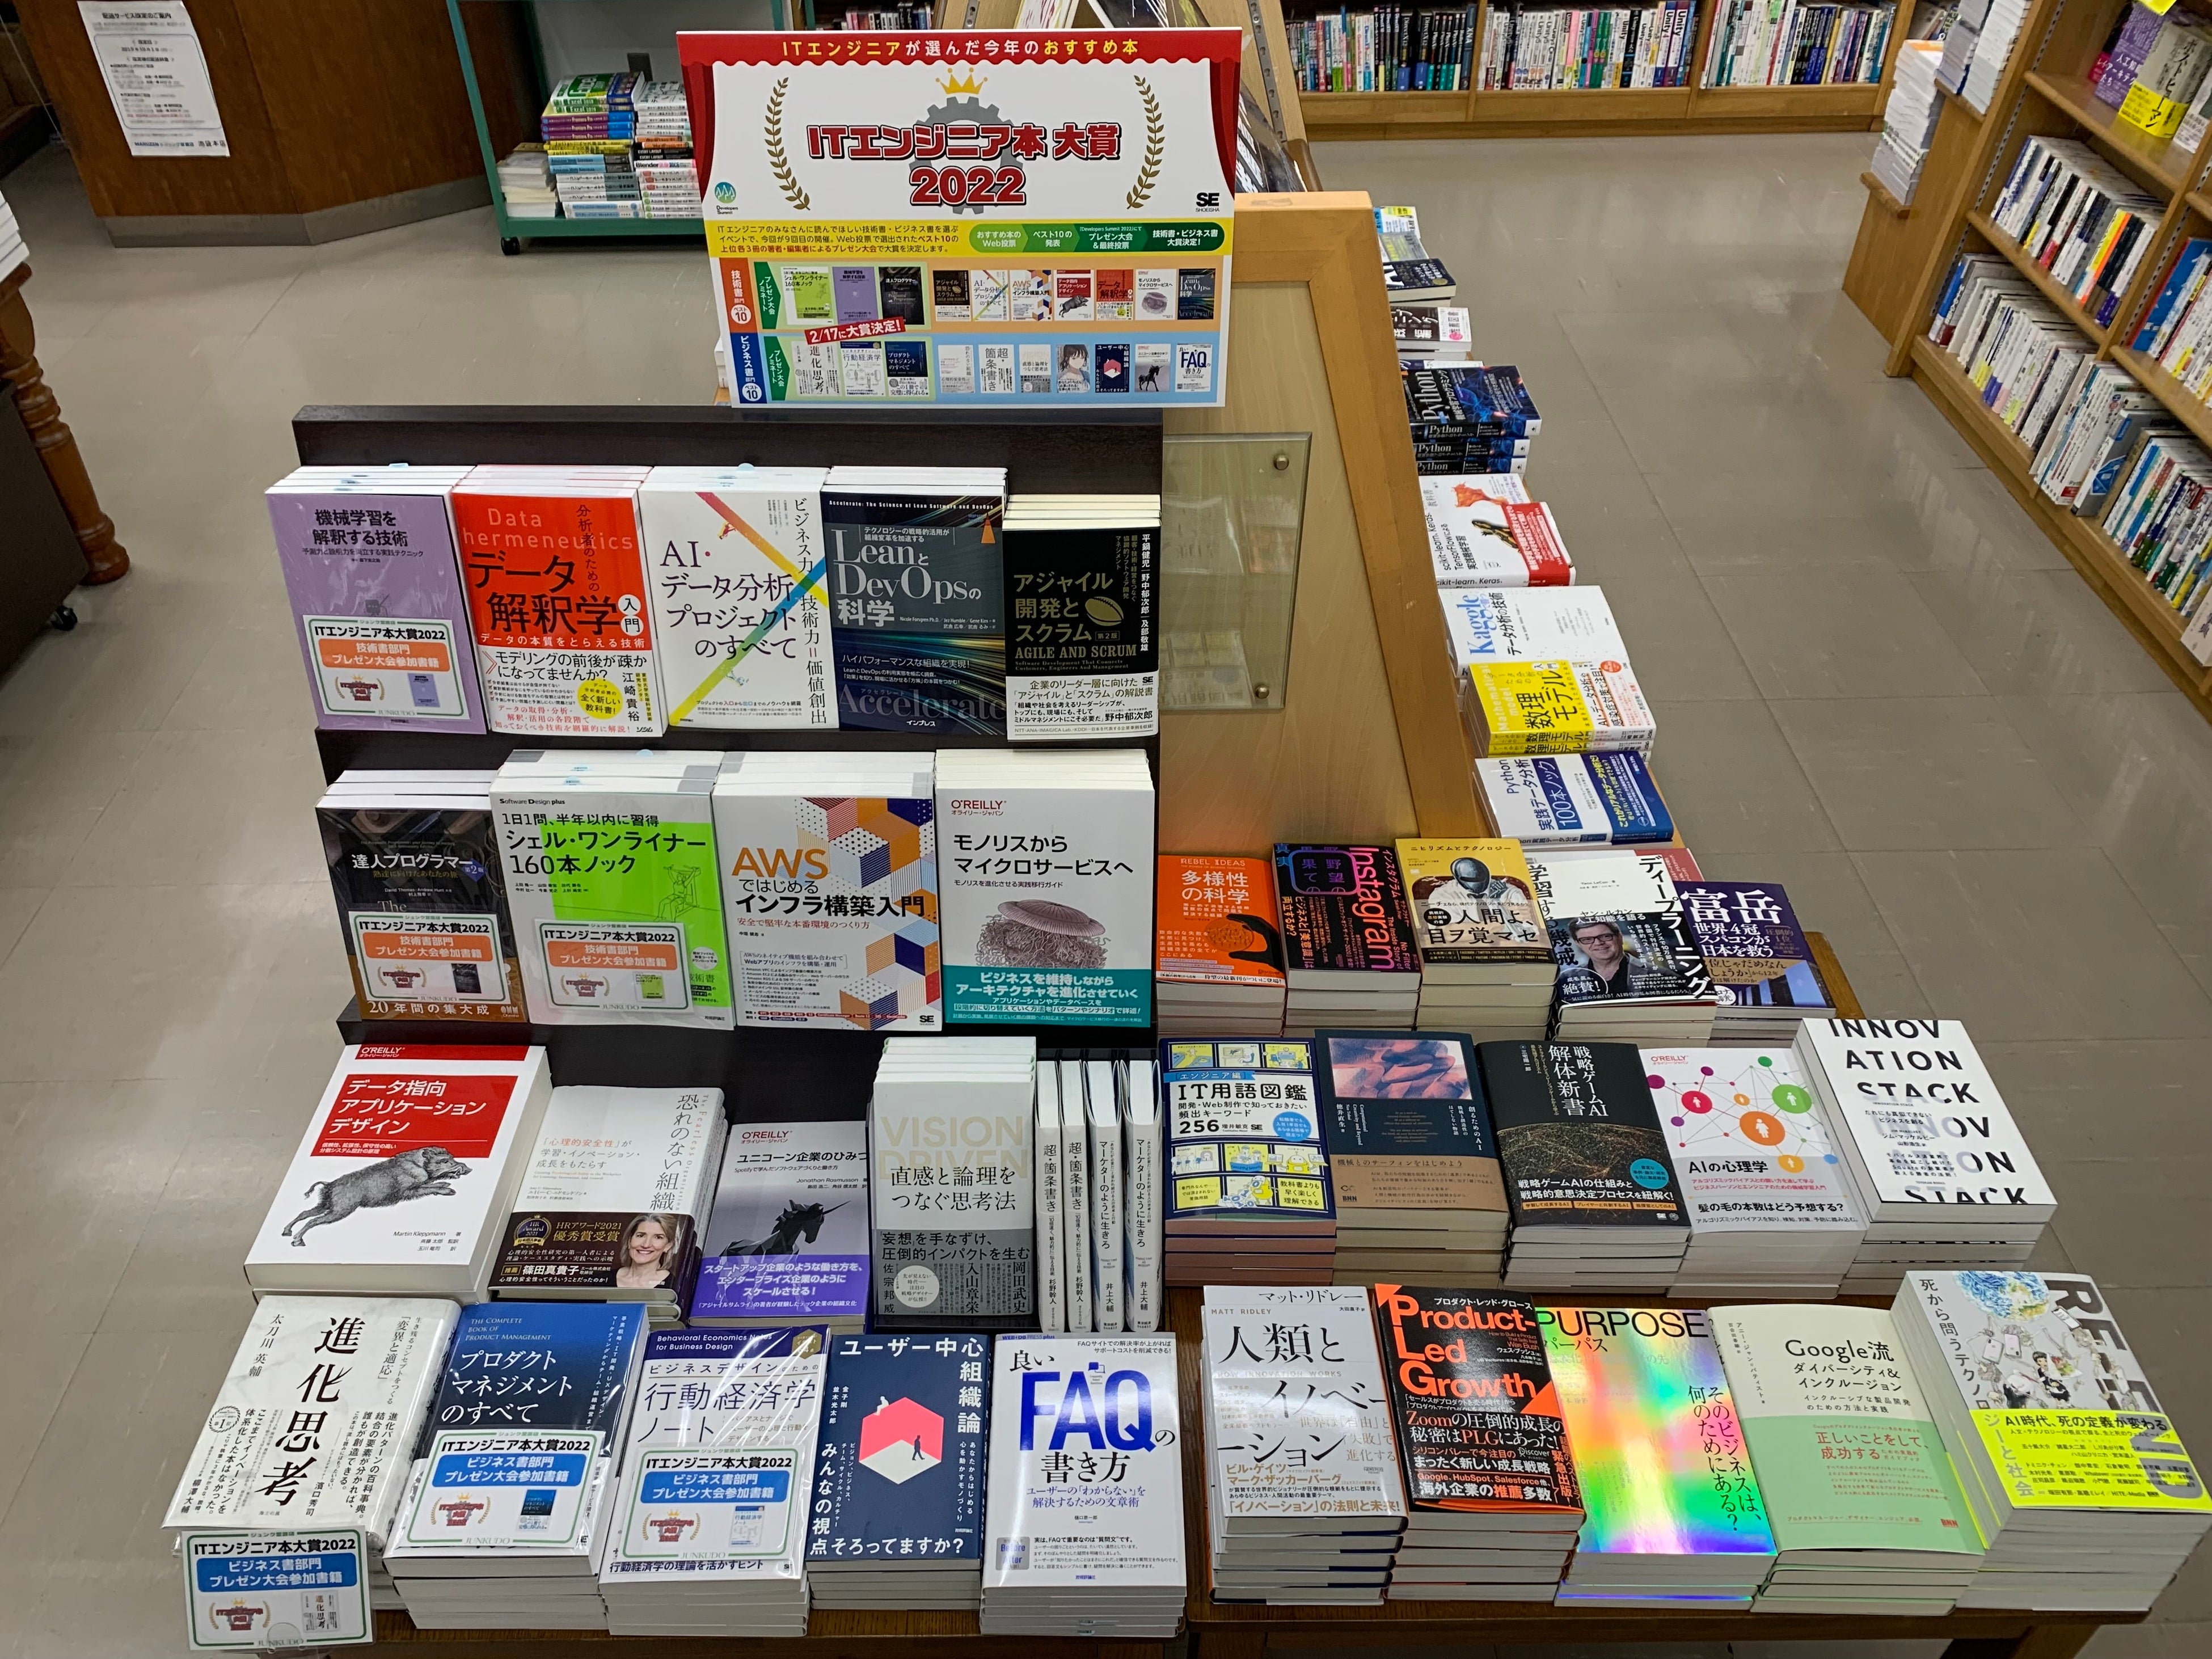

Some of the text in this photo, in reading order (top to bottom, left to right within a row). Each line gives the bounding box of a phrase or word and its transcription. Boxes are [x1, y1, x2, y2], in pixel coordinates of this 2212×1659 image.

[1662, 12, 1674, 33] Unity
[1673, 11, 1686, 36] Unity
[1465, 27, 1474, 44] XNA
[783, 40, 1138, 57] ITエンジニアが選んだ今年のおすすめ本
[910, 167, 1027, 205] 2022
[1196, 192, 1220, 206] SE
[1153, 229, 1218, 238] 技術書・ビジネス書
[1045, 239, 1061, 247] 発表
[735, 311, 748, 322] 10
[809, 319, 901, 342] 2/17に大賞決定!
[1415, 372, 1450, 422] Python
[1429, 425, 1463, 434] Python
[1418, 444, 1451, 453] Python
[315, 509, 396, 526] 機械学習を
[488, 508, 542, 527] Data
[313, 530, 408, 547] 解釈する技術
[864, 527, 949, 535] テクノロジーの戦略的活用が
[831, 529, 928, 565] Leanと
[468, 550, 575, 593] データ
[661, 573, 794, 603] データ分析
[834, 564, 982, 604] DevOpsの
[1014, 571, 1113, 593] アジャイル
[486, 592, 620, 635] 解釈学
[623, 598, 641, 633] 入門
[667, 603, 796, 631] プロジェクト
[838, 599, 895, 627] 科学
[1016, 598, 1079, 619] 開発と
[315, 626, 446, 640] ITエンジニア本大賞2022
[480, 633, 644, 649] データの本質をとらえる技術
[1016, 624, 1092, 642] スクラム
[356, 643, 410, 655] 技術書部門
[695, 635, 796, 660] のすべて
[1016, 644, 1137, 659] AGILE AND SCRUM
[332, 654, 440, 668] プレゼン大会参加書籍
[495, 651, 647, 668] モデリングの前後が疎か
[498, 665, 607, 681] になってませんか?
[1031, 678, 1138, 690] 企業のリーダー層に向けた
[839, 684, 1006, 720] Accelerate
[1541, 670, 1578, 721] モデル
[1105, 711, 1153, 721] 野中郁次郎
[1516, 691, 1556, 730] 数理
[1500, 759, 1519, 794] Python
[1538, 761, 1578, 827] 100本ノック
[503, 813, 660, 828] 1日1問、半年以内に習得
[506, 830, 706, 852] シェル・ワンライナー
[954, 834, 1067, 852] モノリスから
[351, 853, 473, 869] 達人プログラマー
[510, 854, 635, 875] 160本ノック
[732, 847, 829, 880] AWS
[954, 858, 1134, 876] マイクロサービスへ
[739, 879, 819, 894] ではじめる
[1181, 870, 1249, 888] 多様性
[1181, 887, 1250, 904] の科学
[736, 895, 925, 917] インフラ構築入門
[1349, 847, 1395, 969] Instagram
[1679, 889, 1783, 925] 富岳
[1457, 909, 1534, 926] 人間よ、
[1428, 927, 1538, 945] 目ヲ覚マセ
[1639, 855, 1712, 1000] ディープラーニング
[1693, 922, 1761, 936] 世界4冠
[1699, 935, 1771, 945] スパコンが
[1702, 944, 1774, 958] 日本を救う
[980, 972, 1114, 986] ビジネスを維持しながら
[956, 984, 1138, 999] アーキテクチャを進化させていく
[1828, 1019, 1940, 1039] INNOV
[1846, 1050, 1963, 1071] ATION
[347, 1080, 447, 1097] データ指向
[1548, 1044, 1586, 1116] 解体新書
[1573, 1046, 1609, 1117] 戦略ゲームAI
[1178, 1083, 1307, 1100] IT用語図鑑
[1857, 1082, 1980, 1104] STACK
[338, 1099, 487, 1116] アプリケーション
[1179, 1109, 1251, 1119] 頻出キーワード
[328, 1118, 411, 1135] デザイン
[880, 1116, 1024, 1147] VISION
[1179, 1120, 1219, 1134] 256
[1468, 1106, 1483, 1151] 創るためのAI
[649, 1094, 699, 1211] 恐れのない組織
[737, 1152, 867, 1163] ユニコーン企業のひみつ
[537, 1159, 607, 1168] 成長をもたらす
[1688, 1160, 1768, 1174] AIの心理学
[890, 1166, 1016, 1187] 直感と論理を
[1518, 1179, 1633, 1188] 戦略ゲームAIの仕組みと
[892, 1191, 1016, 1211] つなぐ思考法
[1099, 1141, 1111, 1249] マーケターのように生きろ
[1136, 1139, 1146, 1247] マーケターのように生きろ
[556, 1222, 622, 1230] HRアワード2021
[552, 1230, 621, 1242] 優秀賞受賞
[882, 1247, 1030, 1261] 圧倒的インパクトを生む
[1539, 1311, 1709, 1338] PURPOSE
[1217, 1323, 1345, 1364] 人類と
[1393, 1326, 1467, 1363] Led
[1544, 1337, 1608, 1352] パーパス
[1785, 1339, 1894, 1363] Google流
[460, 1350, 558, 1371] プロダクト
[1010, 1349, 1055, 1372] 良い
[451, 1375, 573, 1397] マネジメント
[1399, 1361, 1536, 1399] Growth
[1799, 1377, 1902, 1392] インクルージョン
[644, 1379, 816, 1411] 行動経済学
[254, 1316, 366, 1507] 進化思考
[441, 1403, 539, 1425] のすべて
[638, 1416, 715, 1443] ノート
[1405, 1410, 1565, 1433] Zoomの圧倒的成長の
[441, 1440, 590, 1451] ITエンジニア本大賞2022
[1041, 1451, 1131, 1484] 書き方
[1032, 1497, 1139, 1508] 解決するための文章術
[193, 1538, 357, 1556] ITエンジニア本大賞2022
[229, 1557, 322, 1572] ビジネス書部門
[209, 1571, 343, 1588] プレゼン大会参加書籍
